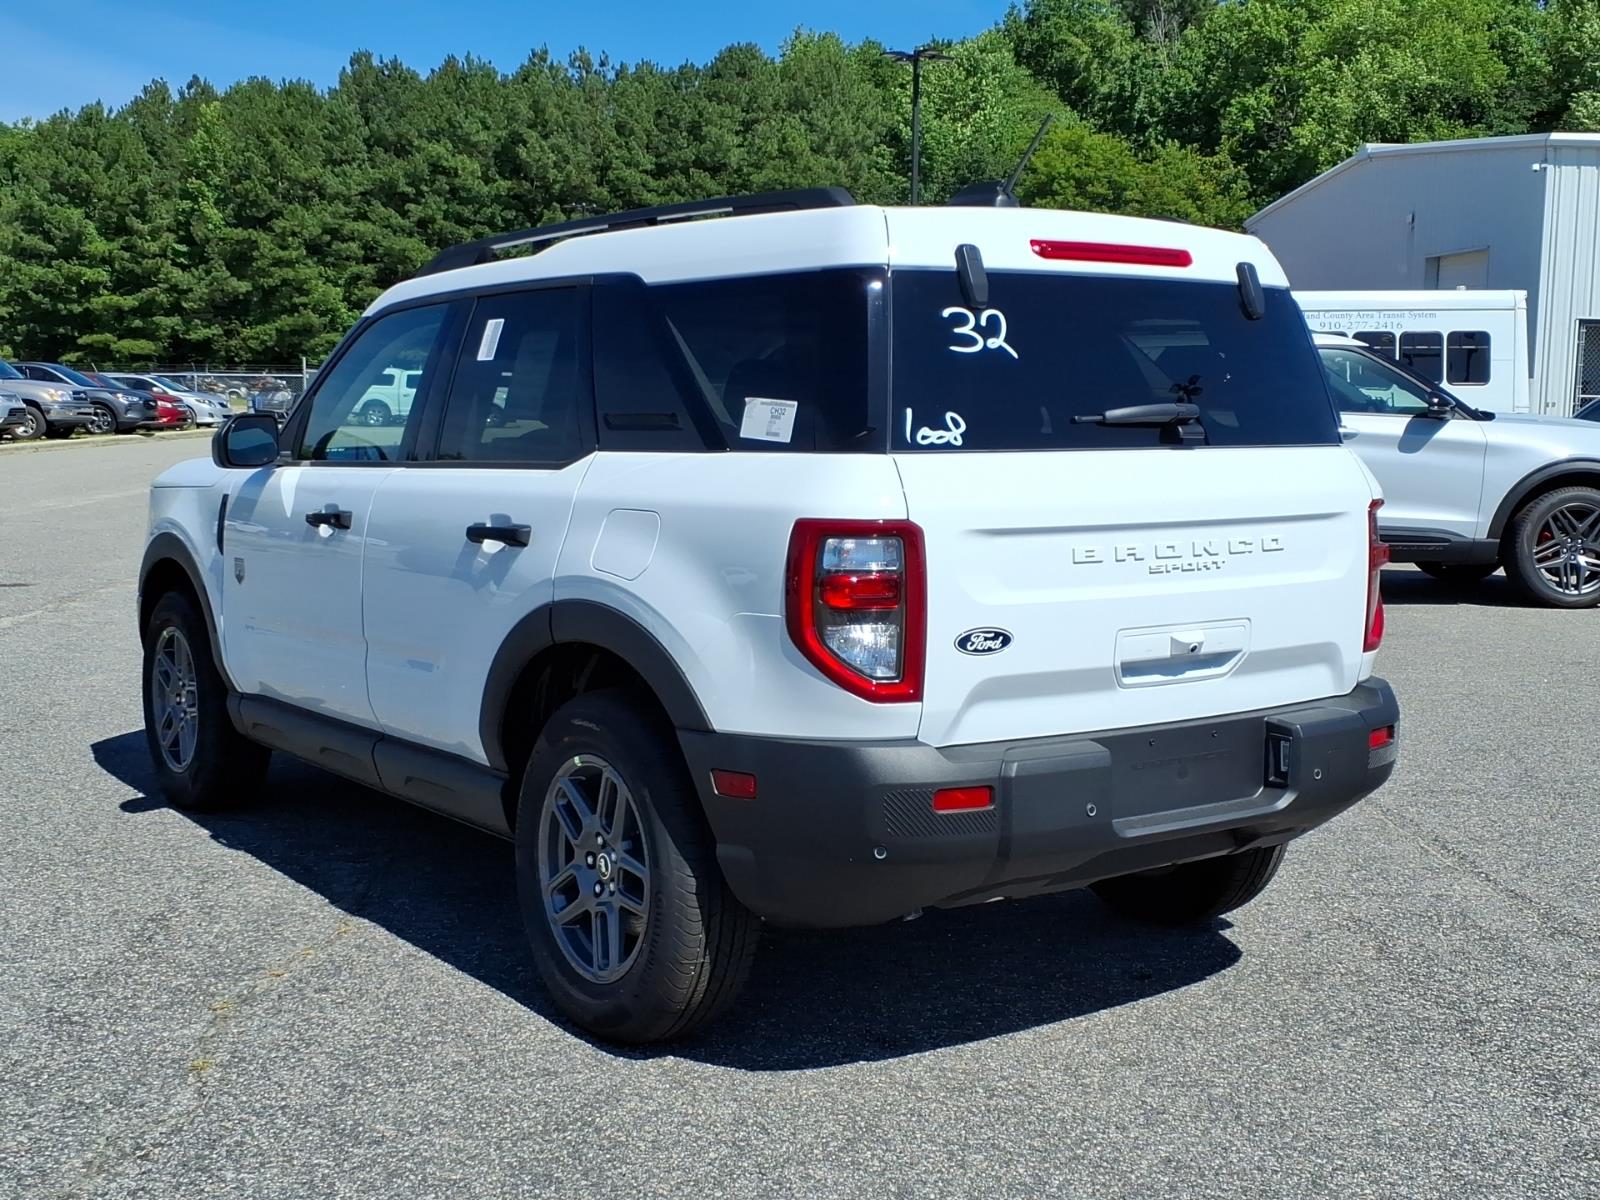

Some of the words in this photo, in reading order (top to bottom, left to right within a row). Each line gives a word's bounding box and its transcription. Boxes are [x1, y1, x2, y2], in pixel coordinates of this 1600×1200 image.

[1323, 312, 1353, 320] County
[1376, 311, 1405, 319] Transit
[1408, 311, 1437, 320] System
[942, 307, 1019, 359] 32
[1319, 321, 1403, 330] 910-277-2416
[906, 407, 967, 446] 1008
[1072, 536, 1285, 565] BRONCO
[1148, 557, 1226, 575] SPORT
[966, 632, 1004, 651] Ford
